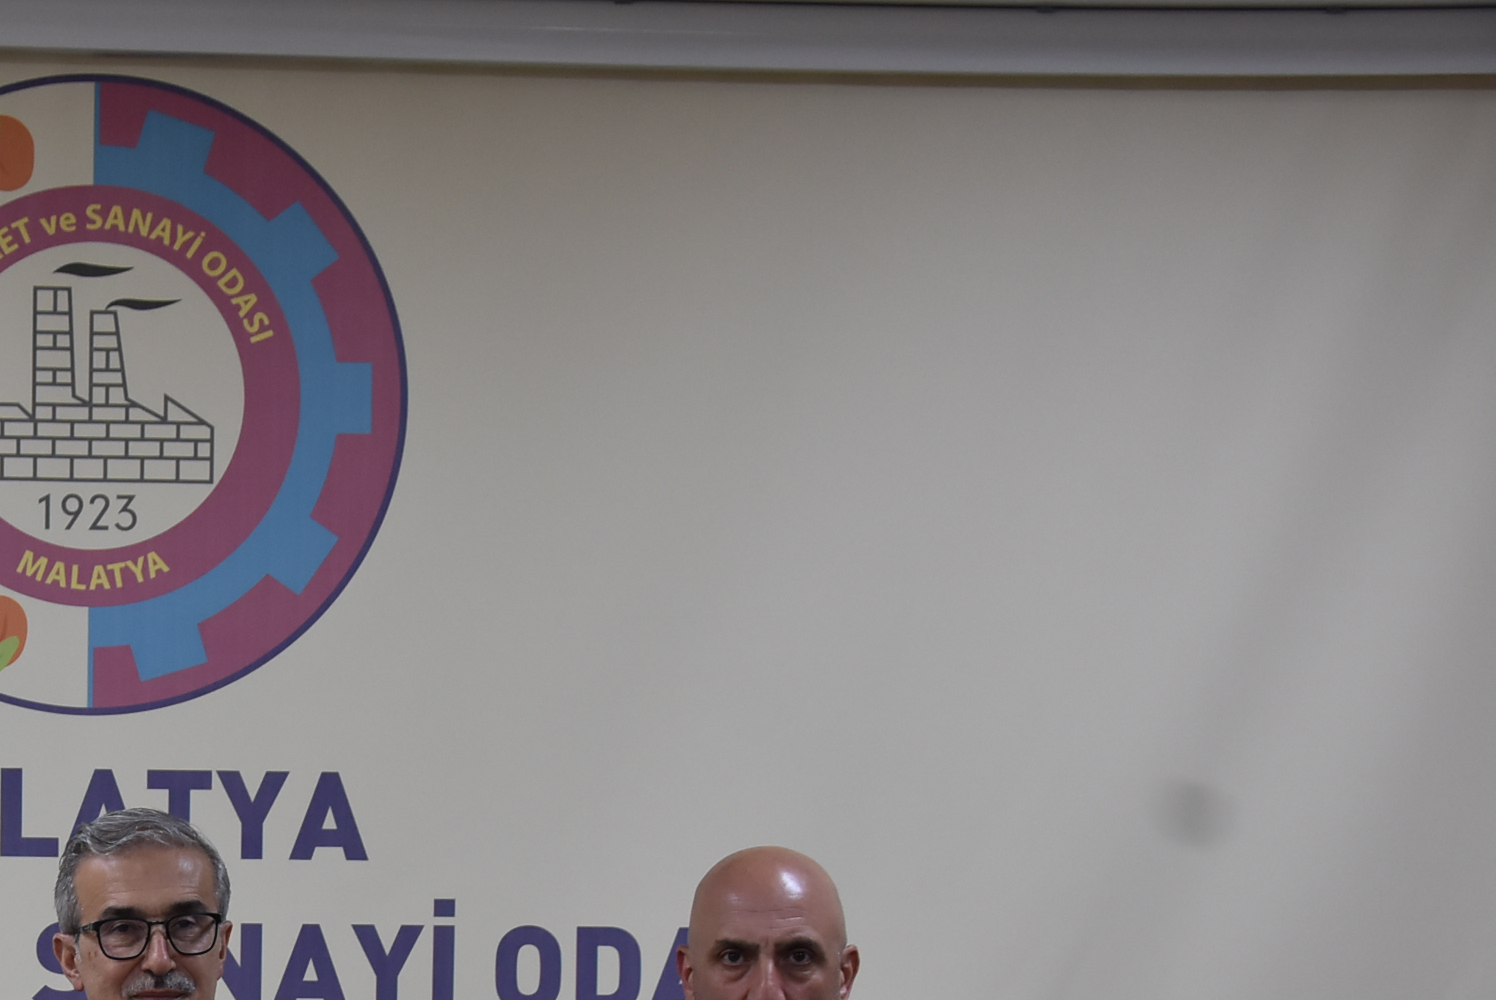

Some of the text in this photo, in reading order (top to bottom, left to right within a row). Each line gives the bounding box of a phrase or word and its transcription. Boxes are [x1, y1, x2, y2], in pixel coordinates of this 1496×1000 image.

[40, 212, 77, 235] ve
[86, 204, 206, 259] SANAYİ
[202, 251, 274, 343] ODASI
[37, 493, 138, 532] 1923
[17, 549, 170, 590] MALATYA
